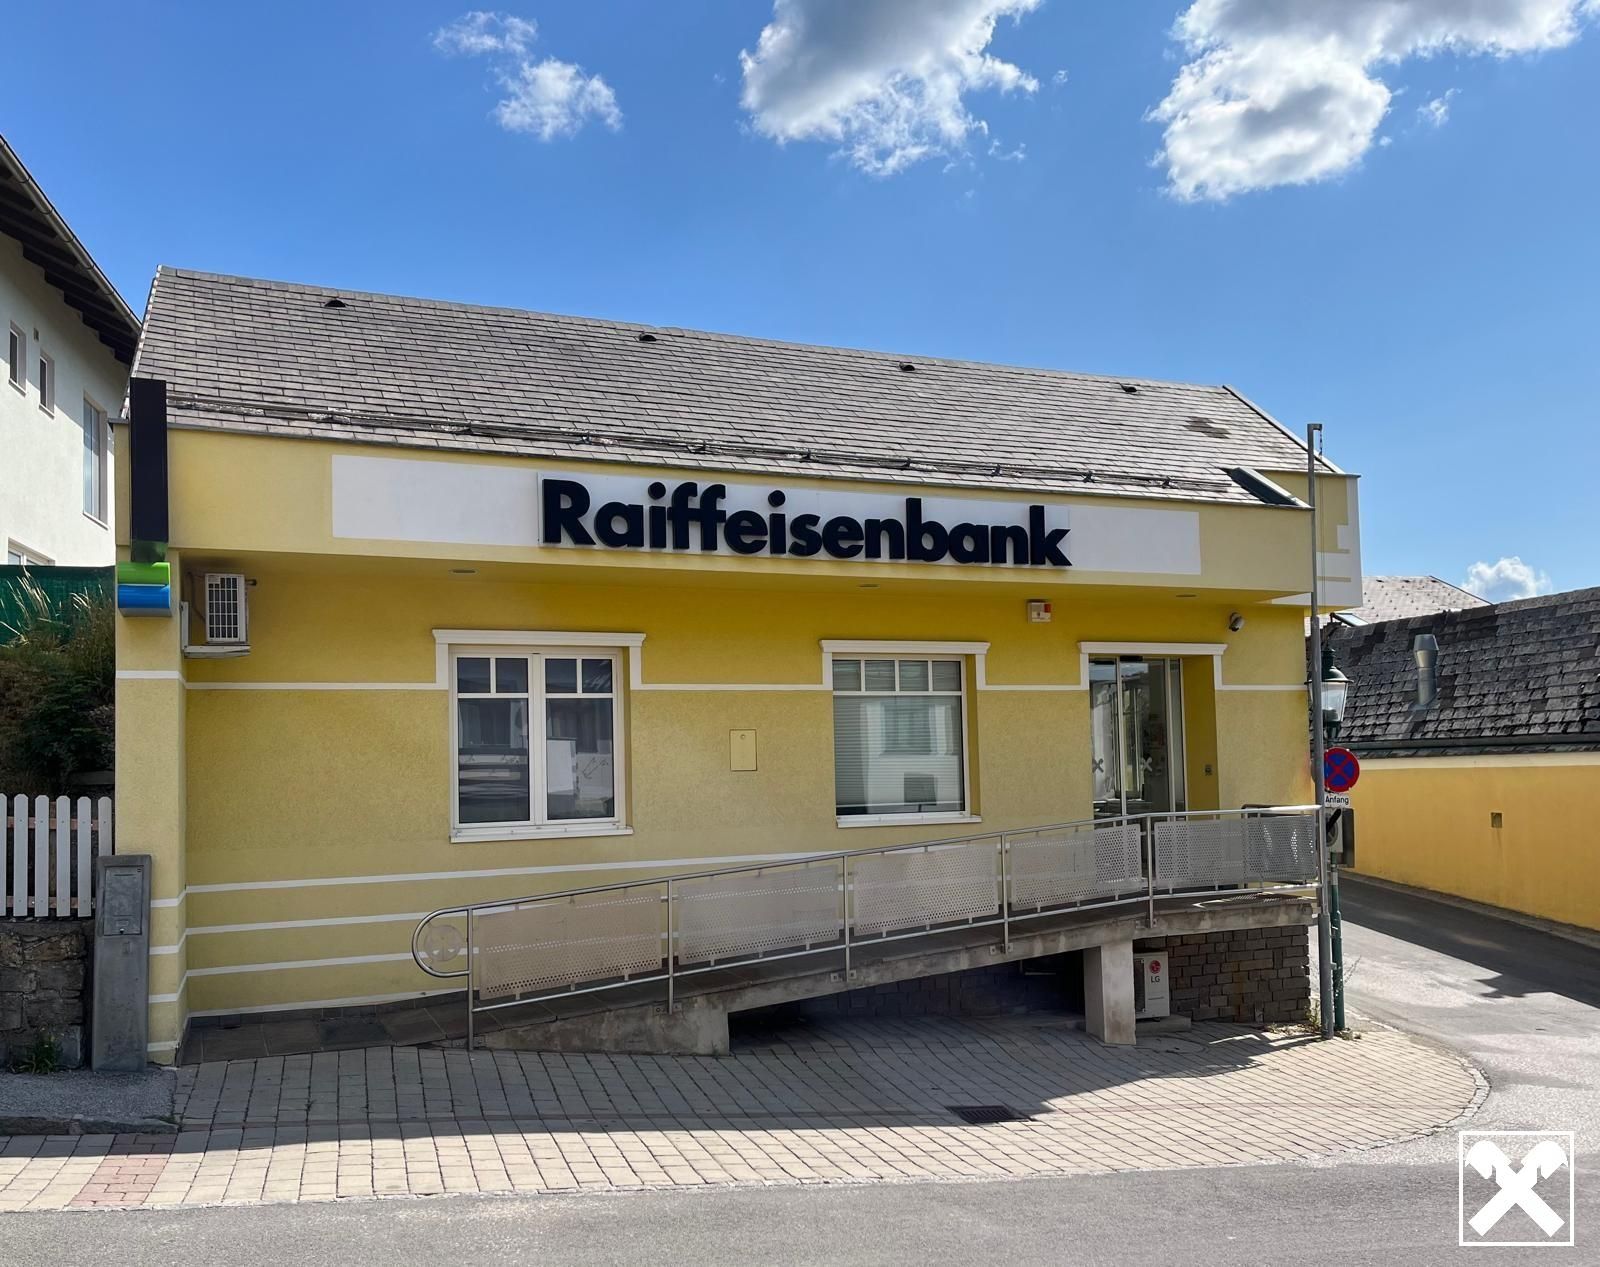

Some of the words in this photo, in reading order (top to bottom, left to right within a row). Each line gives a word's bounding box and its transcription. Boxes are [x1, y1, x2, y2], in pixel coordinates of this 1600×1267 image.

[541, 478, 1073, 567] Raiffeisenbank
[1325, 795, 1349, 805] Anfang
[1150, 975, 1161, 983] LG
